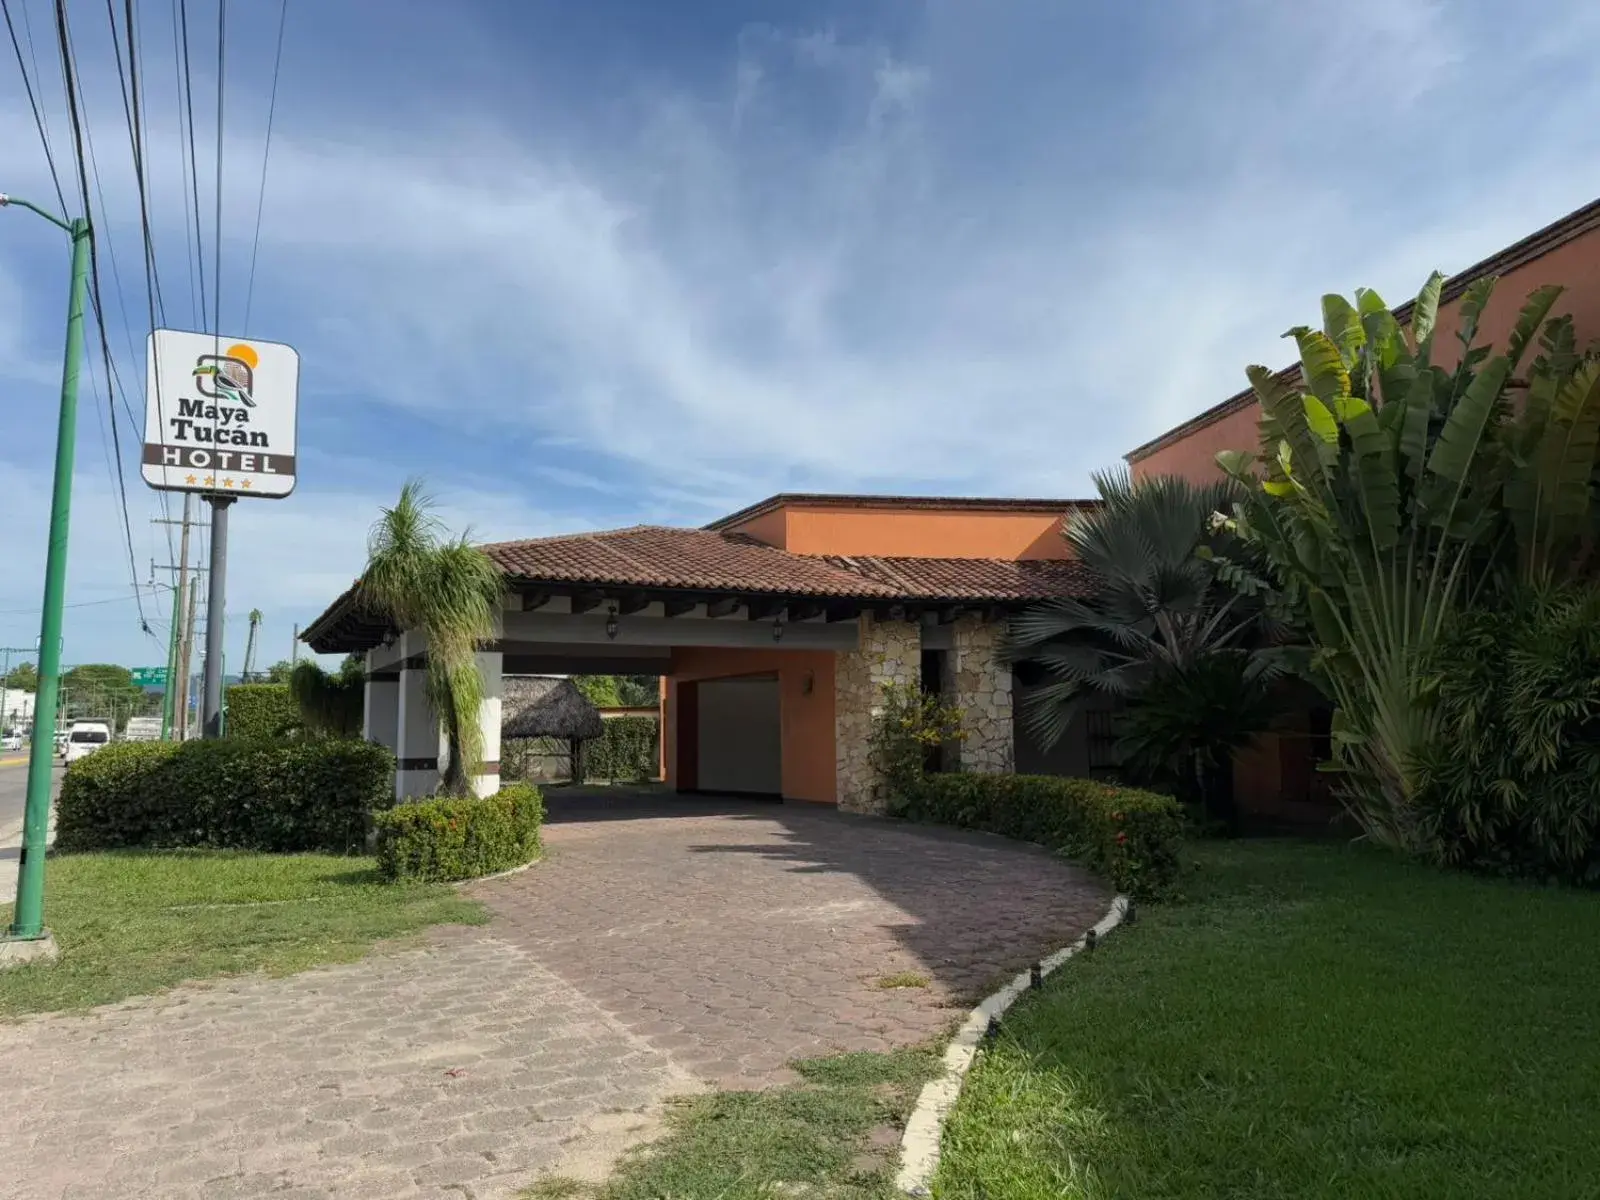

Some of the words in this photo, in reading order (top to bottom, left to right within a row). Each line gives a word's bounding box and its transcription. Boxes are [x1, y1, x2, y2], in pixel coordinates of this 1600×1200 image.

[178, 398, 249, 426] Maya
[170, 418, 269, 448] Tucán
[162, 447, 276, 473] HOTEL
